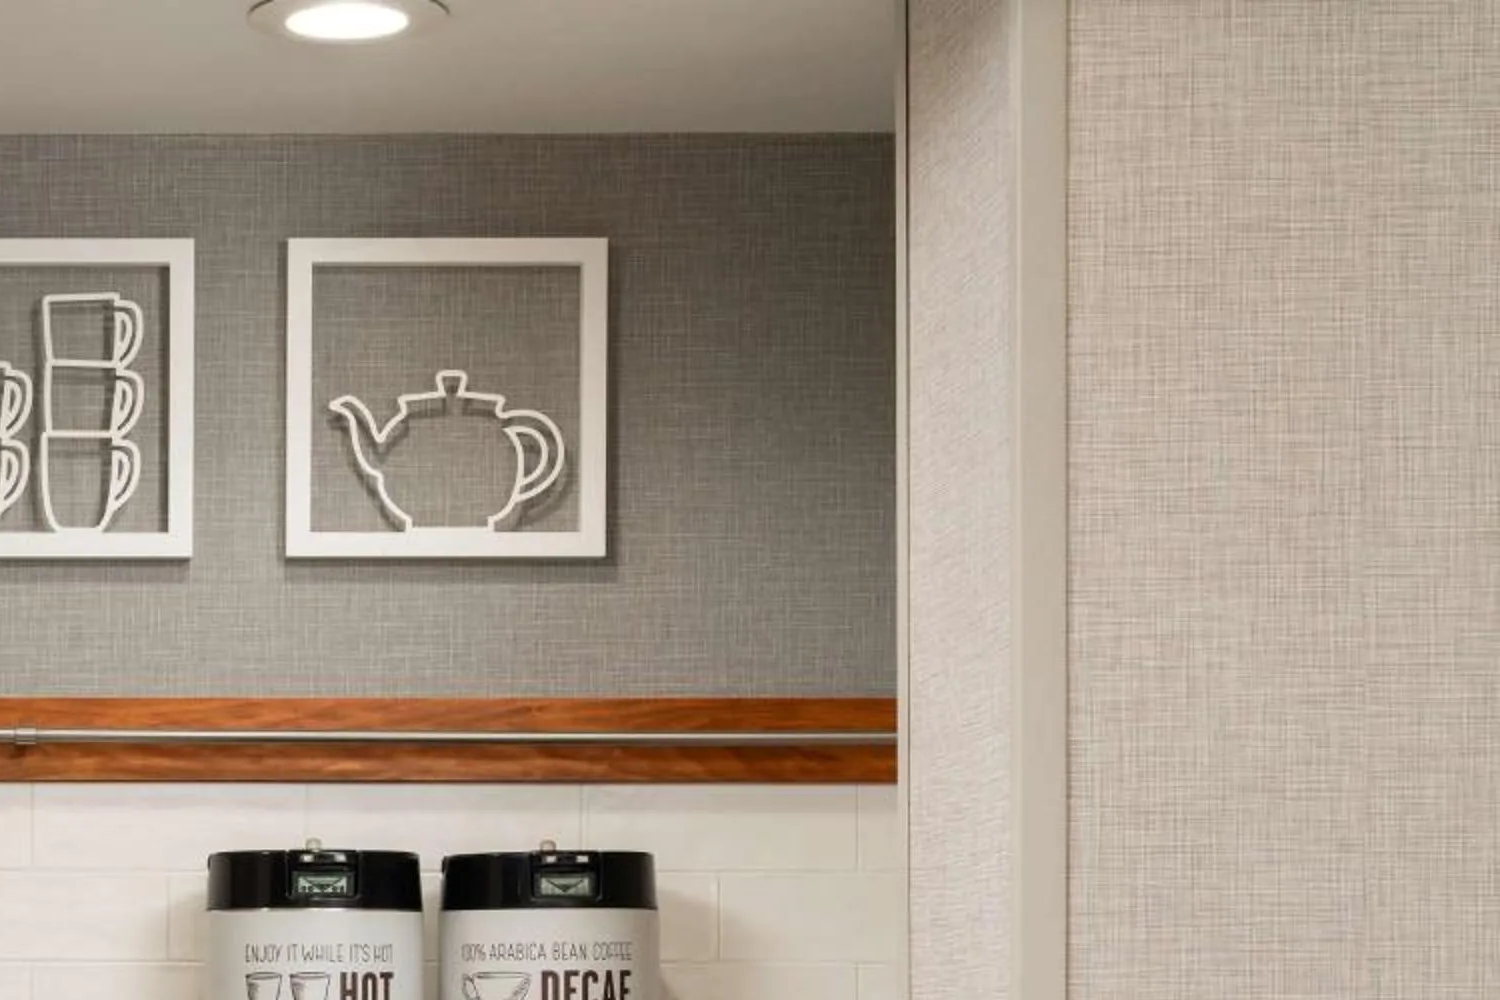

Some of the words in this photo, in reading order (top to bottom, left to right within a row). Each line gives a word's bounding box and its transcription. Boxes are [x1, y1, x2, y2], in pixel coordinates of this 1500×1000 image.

[245, 943, 281, 963] ENJOY
[286, 943, 298, 962] IT
[301, 943, 343, 962] WHILE
[373, 943, 394, 963] HOT
[489, 943, 547, 961] ARABICA
[552, 942, 587, 961] BEAN
[592, 941, 633, 960] COFFEE
